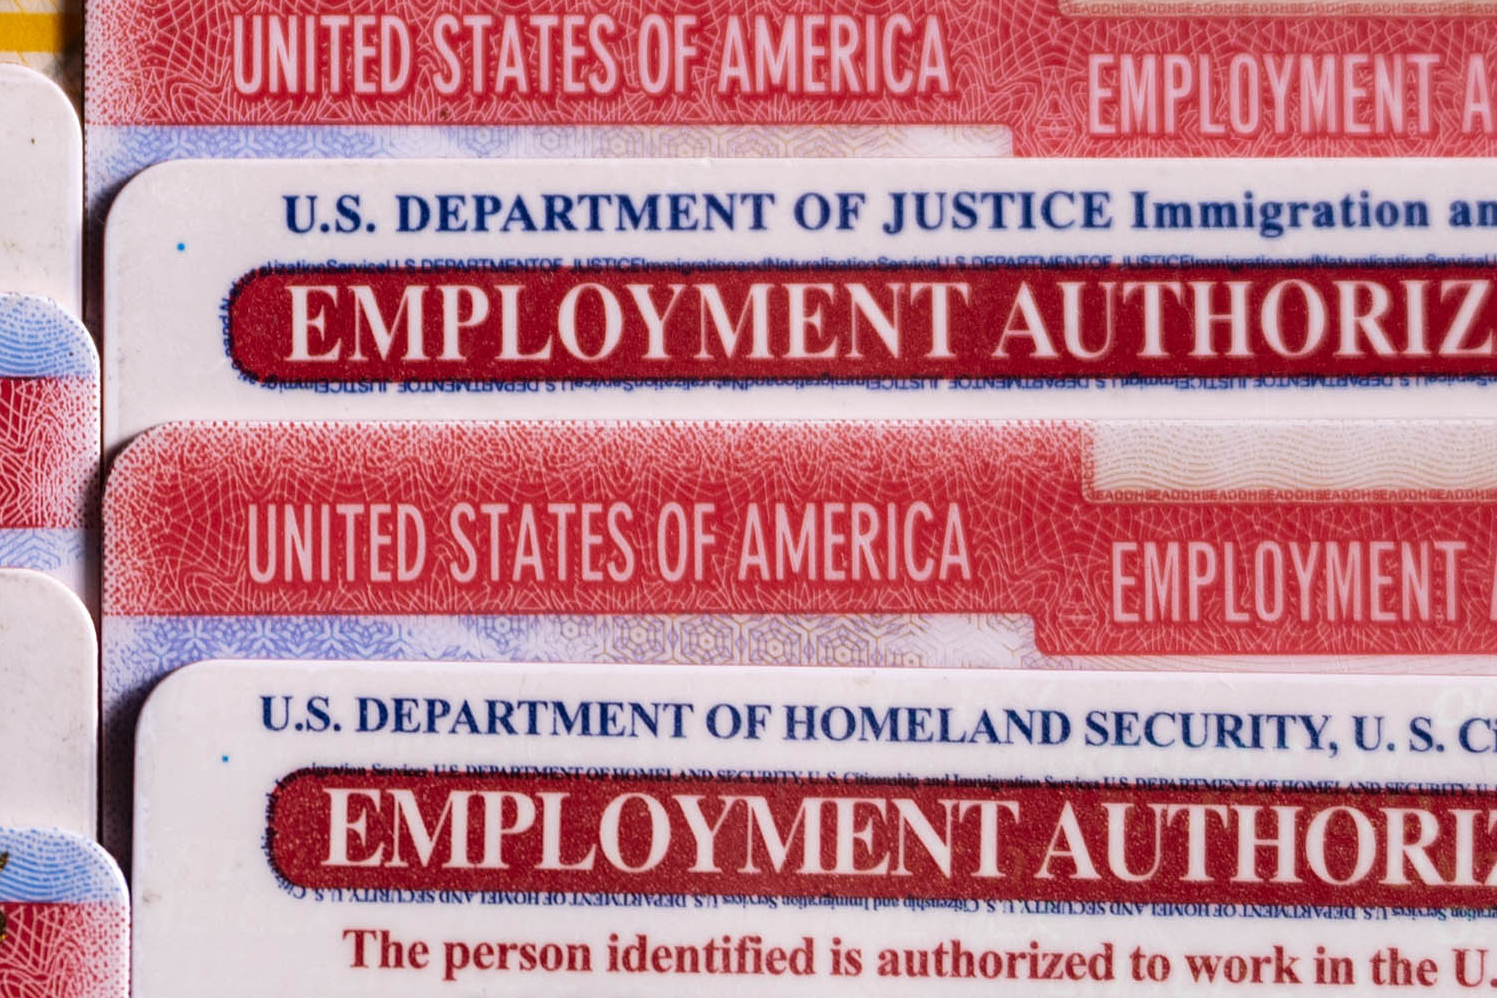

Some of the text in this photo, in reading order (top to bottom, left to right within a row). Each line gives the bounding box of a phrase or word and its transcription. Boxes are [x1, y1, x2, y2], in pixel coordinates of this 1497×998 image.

[234, 13, 951, 95] UNITED STATES OF AMERICA
[1087, 52, 1441, 138] EMPLOYMENT
[285, 193, 376, 234] U.S.
[395, 192, 775, 233] DEPARTMENT
[793, 191, 866, 232] OF
[882, 190, 1112, 235] JUSTICE
[1130, 190, 1430, 239] Immigration
[286, 281, 970, 363] EMPLOYMENT
[994, 279, 1495, 361] AUTHORIZ
[246, 501, 973, 585] UNITED STATES OF AMERICA
[1112, 540, 1466, 624] EMPLOYMENT
[260, 694, 342, 733] U.S.
[356, 696, 693, 740] DEPARTMENT
[706, 702, 773, 742] OF
[784, 703, 1072, 747] HOMELAND
[1084, 708, 1340, 759] SECURITY,
[1353, 714, 1396, 753] U.
[1408, 716, 1446, 754] S.
[321, 786, 1021, 878] EMPLOYMENT
[1037, 801, 1497, 889] AUTHORI
[439, 889, 540, 905] HOMELAND
[543, 891, 567, 906] OF
[570, 893, 687, 909] DEPARTMENT
[1110, 901, 1209, 917] HOMELAND
[1213, 902, 1237, 917] OF
[1240, 902, 1356, 919] DEPARTMENT
[344, 929, 430, 970] The
[444, 938, 592, 981] person
[606, 933, 815, 978] identified
[829, 939, 863, 978] is
[876, 936, 1115, 982] authorized
[1129, 946, 1171, 983] to
[1184, 940, 1301, 986] work
[1314, 946, 1355, 986] in
[1369, 945, 1439, 987] the
